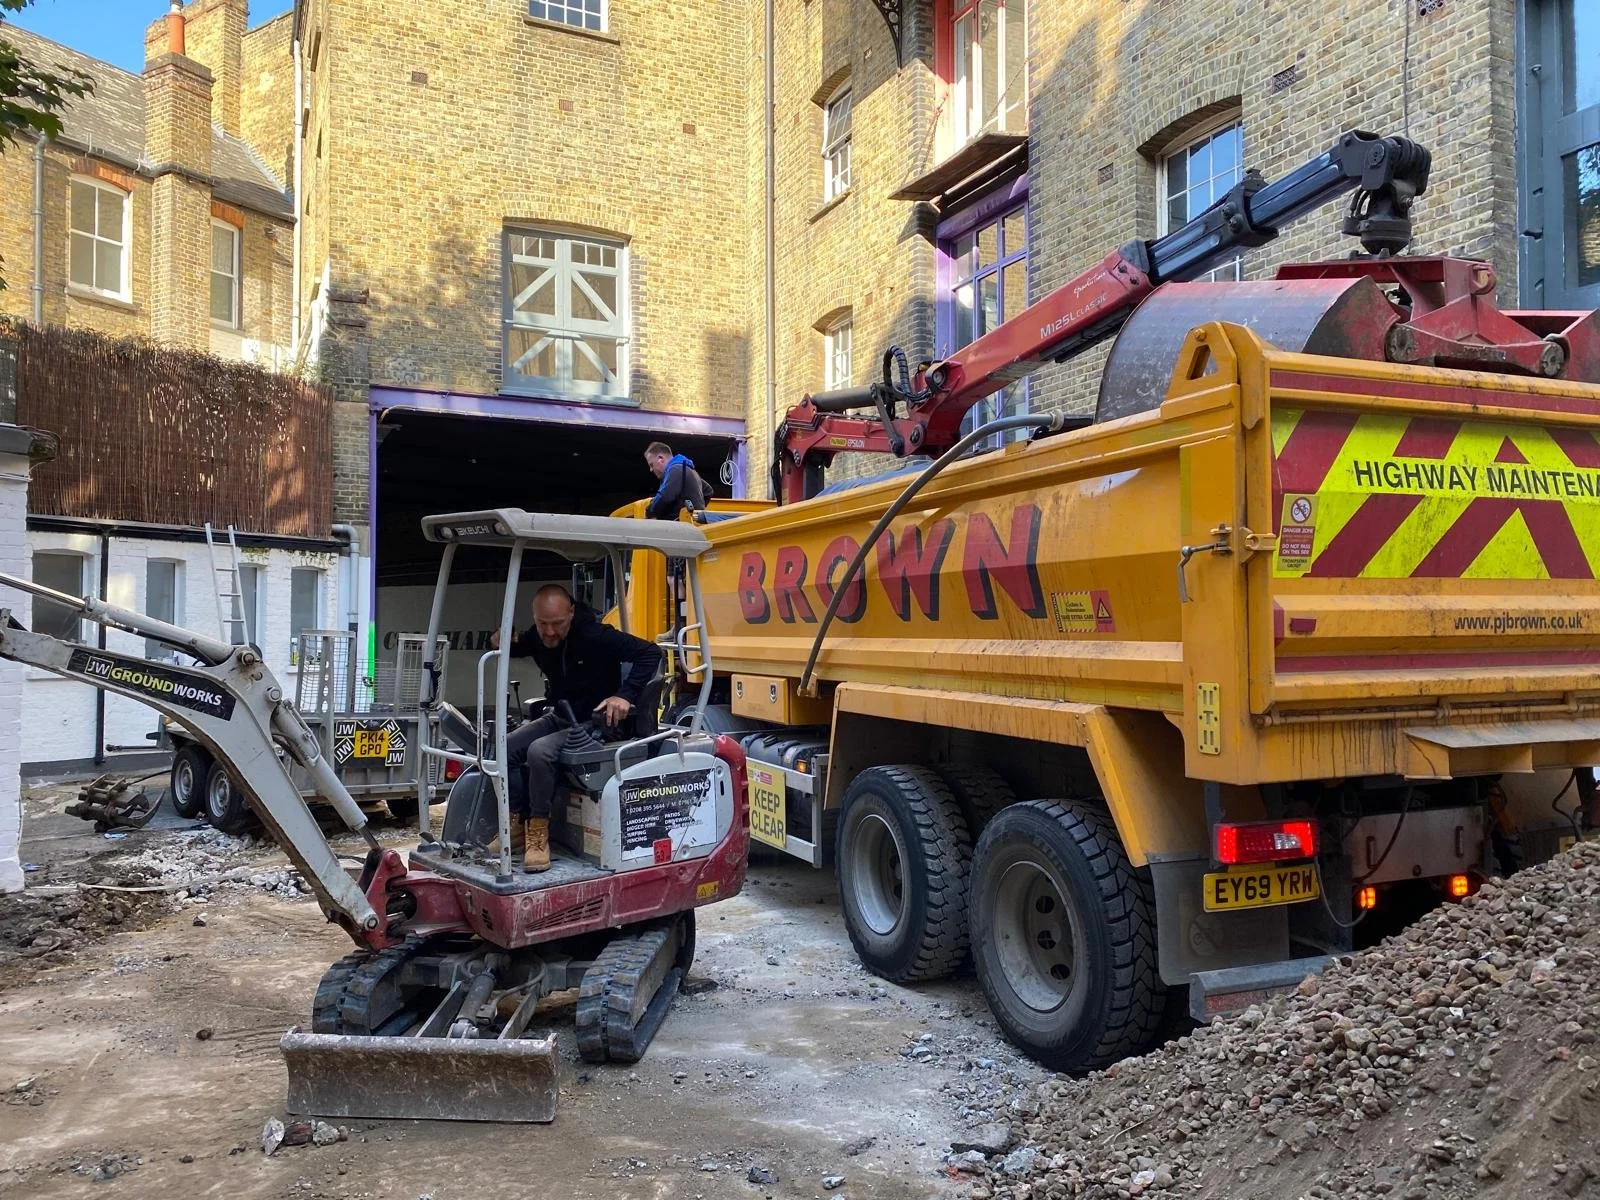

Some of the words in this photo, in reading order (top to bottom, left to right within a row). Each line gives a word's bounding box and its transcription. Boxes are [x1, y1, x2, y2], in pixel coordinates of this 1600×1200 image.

[1353, 460, 1478, 491] HIGHWAY
[738, 503, 1048, 624] BROWN
[1454, 611, 1583, 635] www.pjbrown.co.uk
[87, 661, 110, 675] JW
[111, 667, 223, 706] GROUNDWORKS
[337, 724, 354, 735] JW
[360, 732, 385, 743] PK14
[336, 741, 352, 760] JW
[360, 744, 382, 755] GPO
[387, 752, 403, 763] JW
[639, 781, 710, 799] GROUNDWORKS
[754, 786, 780, 814] KEEP
[626, 815, 660, 826] LANDSCAPING
[751, 809, 784, 842] CLEAR
[1215, 874, 1271, 904] EY69
[1277, 869, 1313, 897] YRW
